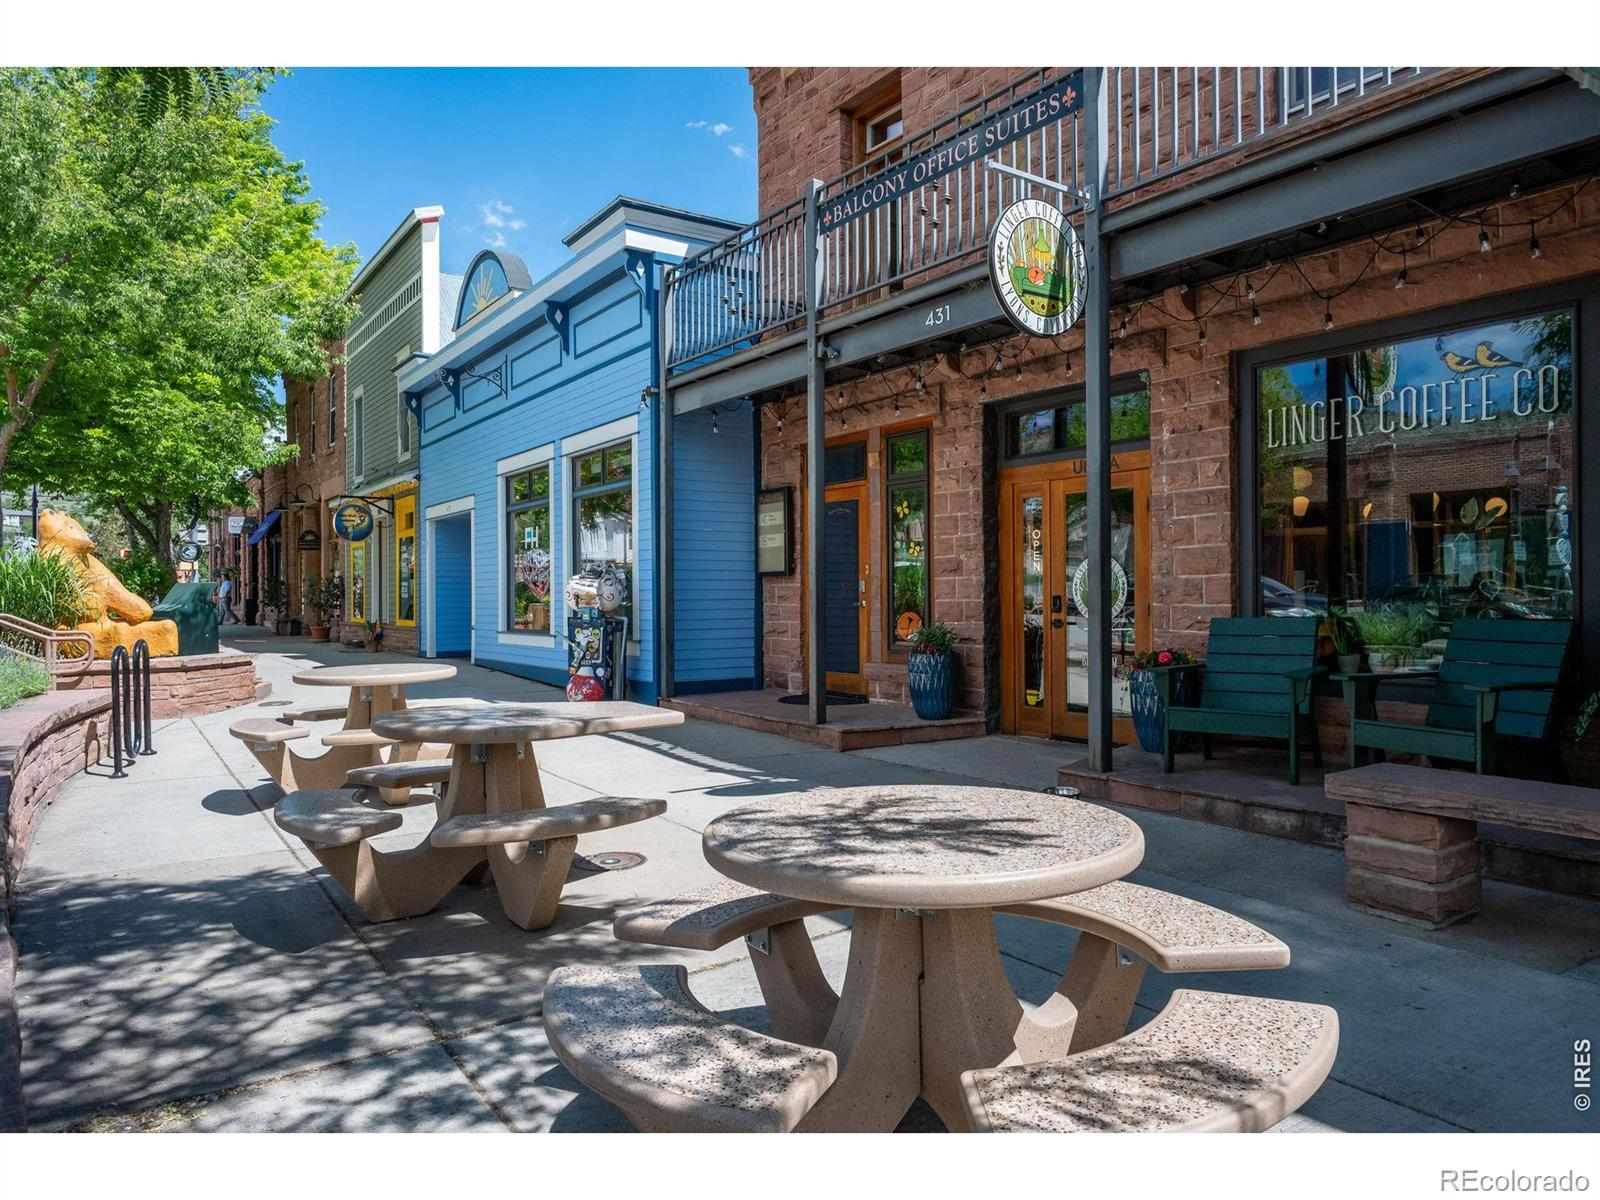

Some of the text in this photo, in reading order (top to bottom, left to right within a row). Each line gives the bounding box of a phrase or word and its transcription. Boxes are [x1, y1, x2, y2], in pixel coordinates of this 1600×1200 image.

[832, 92, 1061, 224] BALCONY OFFICE SUITES
[998, 201, 1030, 240] LINGER
[925, 304, 950, 326] 431
[1267, 395, 1363, 449] LINGER
[1379, 374, 1497, 434] COFFEE
[1512, 364, 1560, 417] CO
[1031, 529, 1041, 571] OPEN
